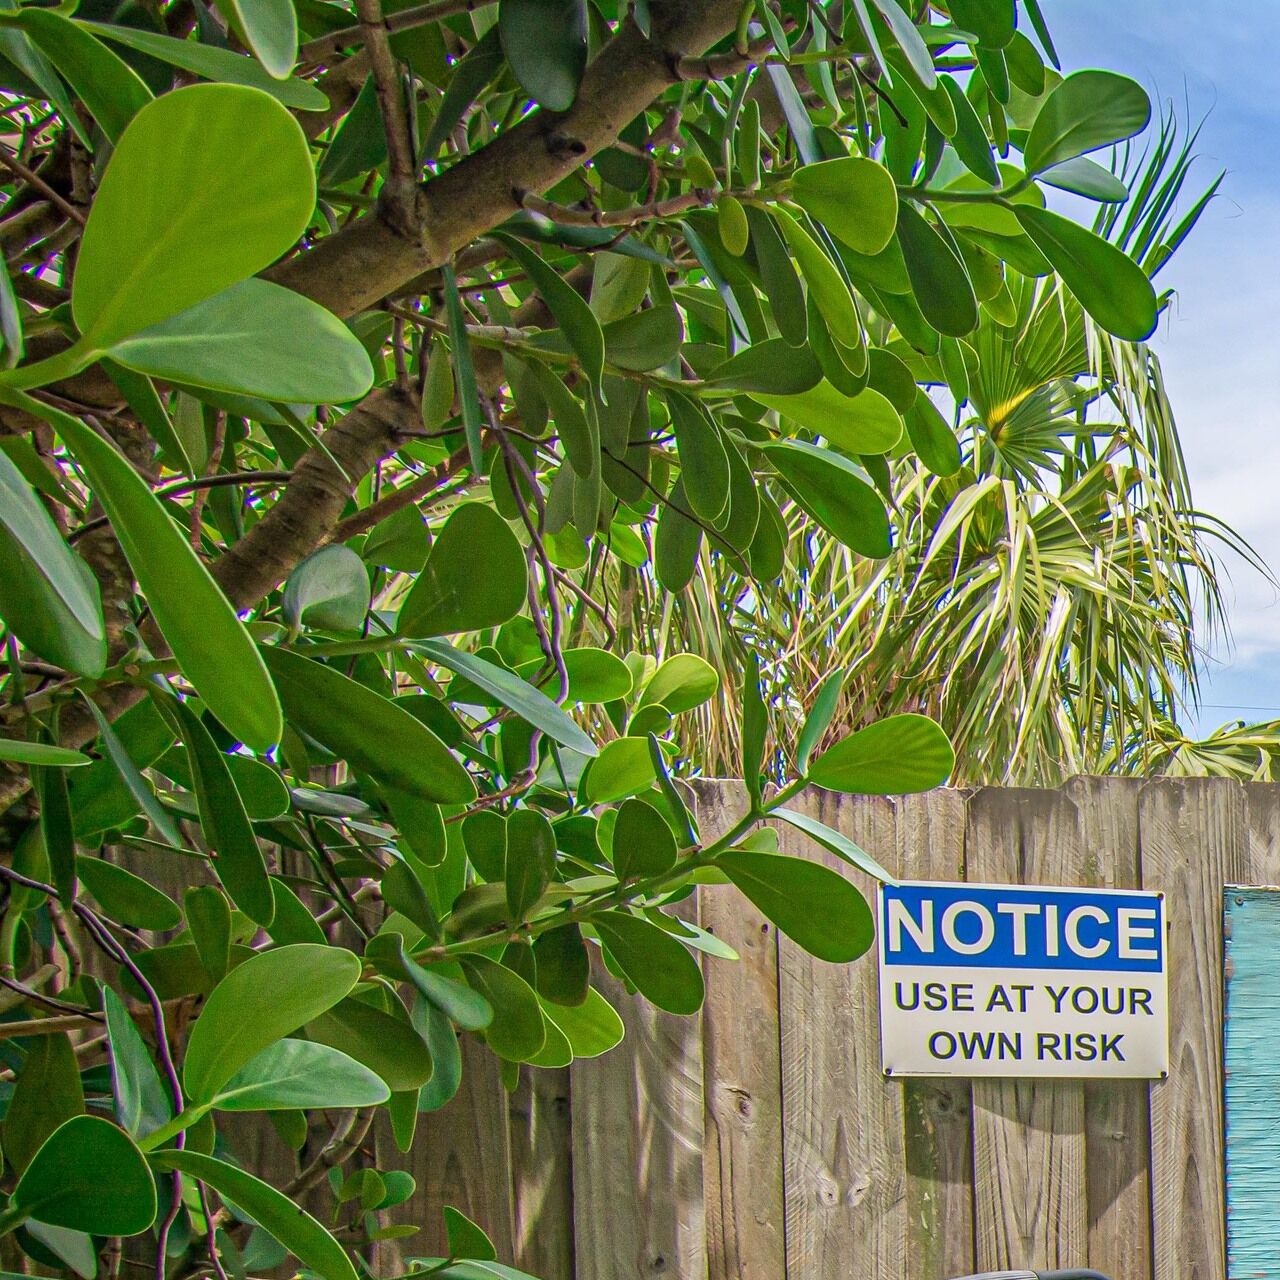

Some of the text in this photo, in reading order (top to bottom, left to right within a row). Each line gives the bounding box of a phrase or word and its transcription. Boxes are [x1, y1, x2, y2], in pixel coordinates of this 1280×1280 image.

[888, 899, 1158, 960] NOTICE
[894, 982, 1154, 1016] USE AT YOUR
[928, 1031, 1126, 1062] OWN RISK
